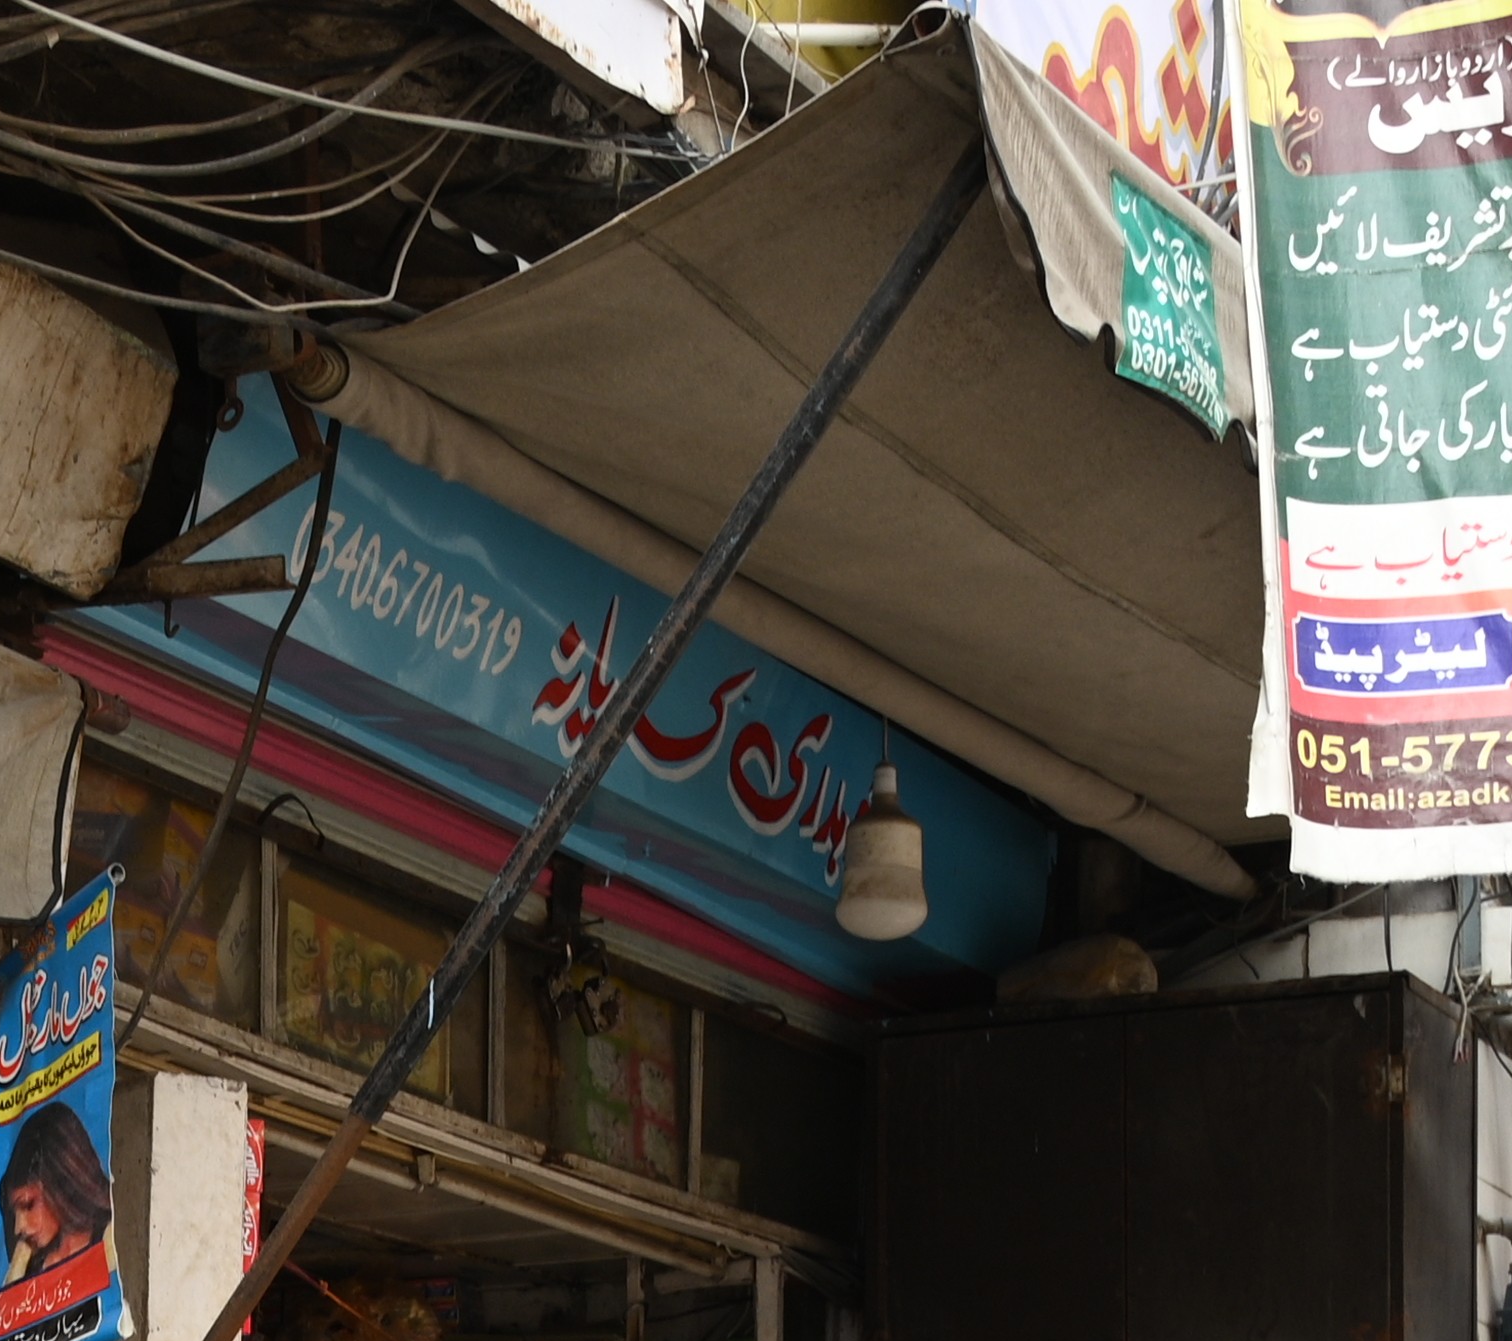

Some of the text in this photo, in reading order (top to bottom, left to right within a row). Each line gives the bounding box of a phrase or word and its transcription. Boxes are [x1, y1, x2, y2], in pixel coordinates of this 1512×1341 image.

[1294, 427, 1351, 480] ہے
[1357, 384, 1430, 472] جاتی
[1438, 380, 1488, 460] کی
[1305, 545, 1364, 590] ہے
[1314, 622, 1488, 691] لیٹر پیڈ
